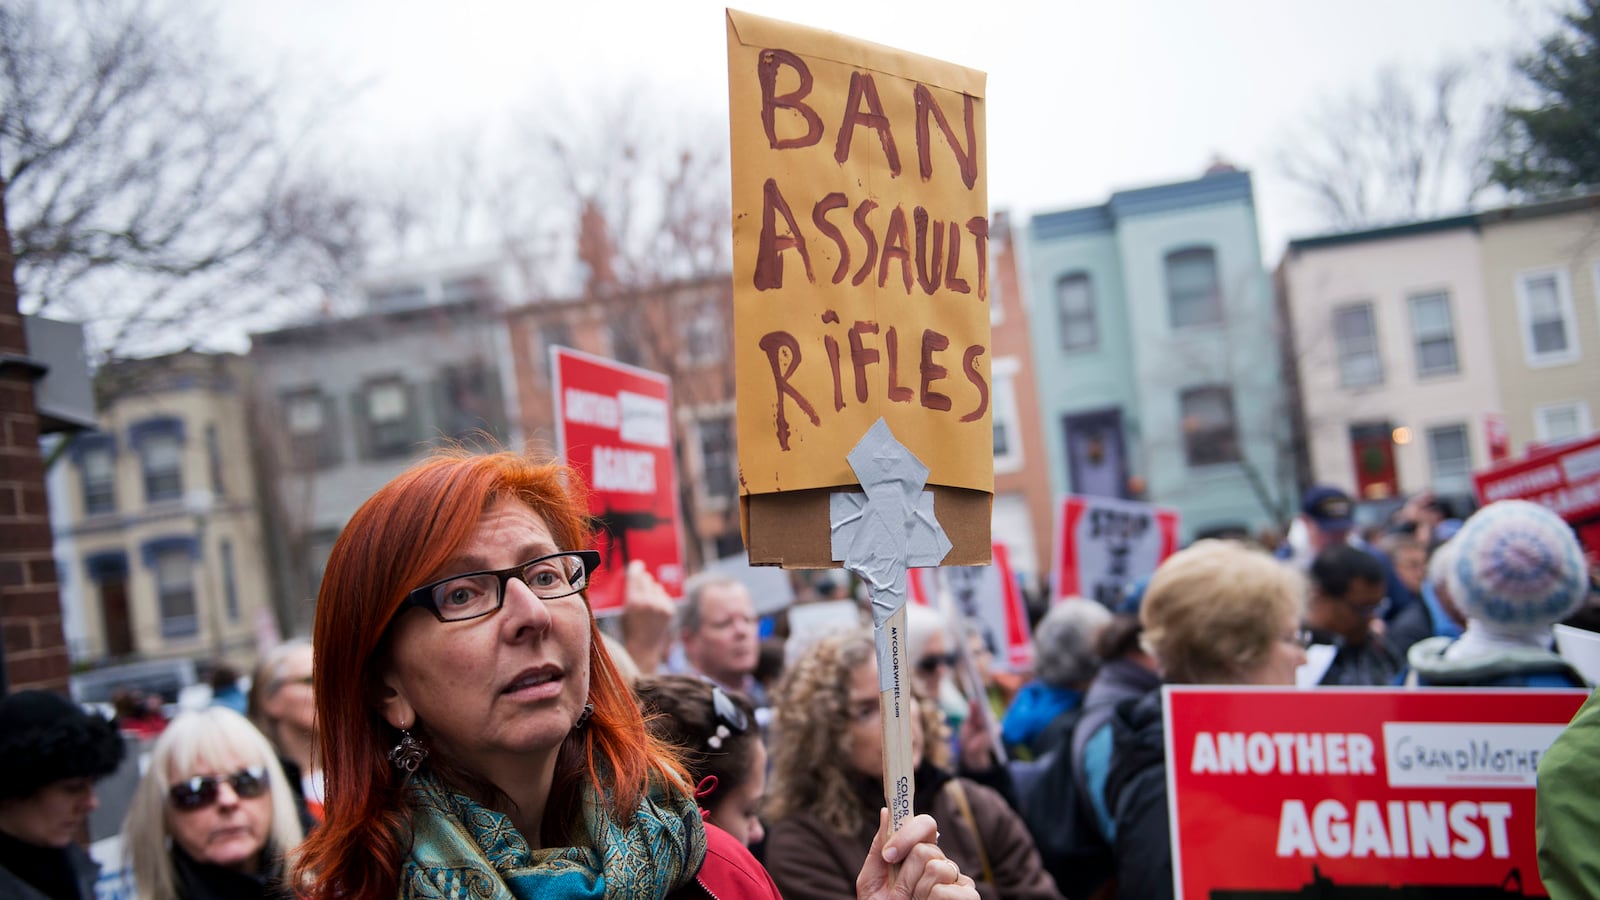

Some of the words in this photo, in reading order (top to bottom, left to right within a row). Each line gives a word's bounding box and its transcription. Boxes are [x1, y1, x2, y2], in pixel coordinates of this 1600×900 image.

[757, 48, 979, 191] BAN
[753, 178, 989, 302] ASSAULT
[758, 309, 989, 451] RIFLES
[891, 626, 900, 718] MYCOLORWHEEL.com
[900, 776, 909, 817] COLOR
[1191, 732, 1376, 775] ANOTHER
[1395, 735, 1538, 773] GRANDMOTHE
[1276, 799, 1512, 859] AGAINST
